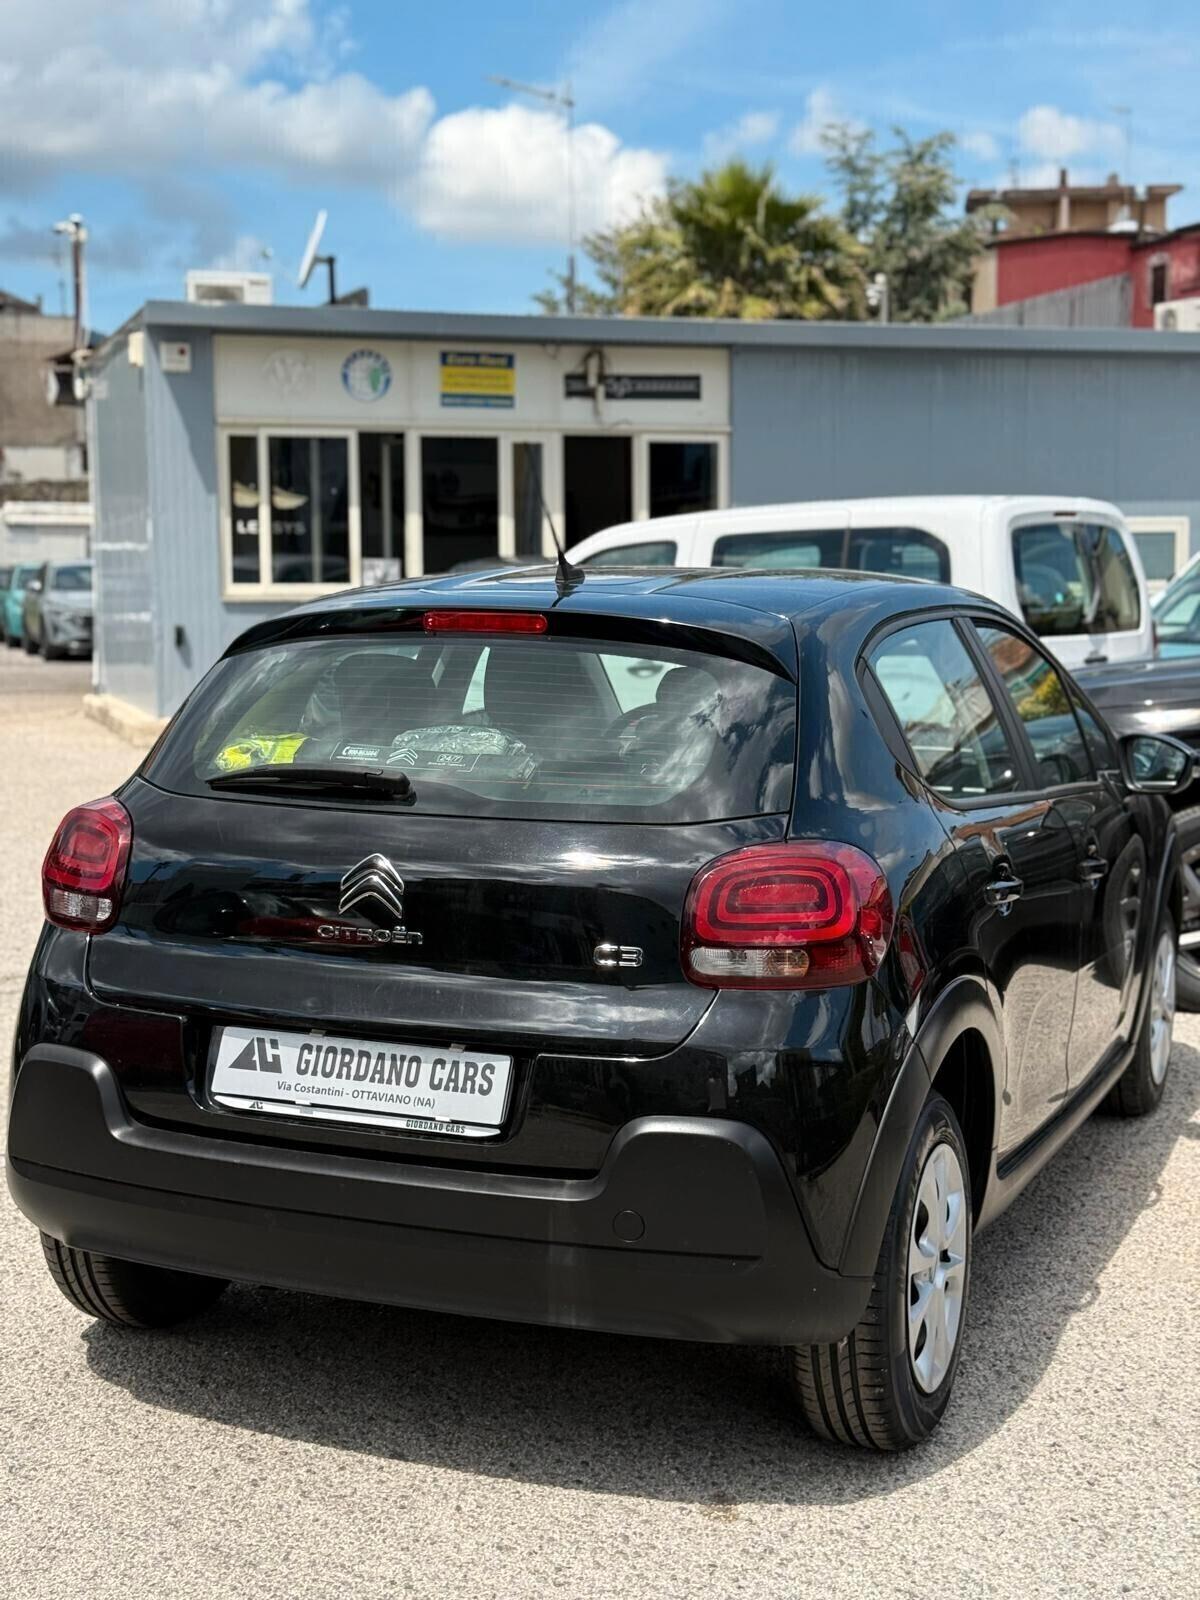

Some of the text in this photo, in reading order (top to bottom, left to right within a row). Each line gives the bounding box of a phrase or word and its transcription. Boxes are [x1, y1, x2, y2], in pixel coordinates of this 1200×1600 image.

[236, 519, 306, 535] LESYS
[593, 943, 643, 967] C3
[296, 1042, 496, 1096] GIORDANO CARS
[277, 1080, 292, 1092] Via
[294, 1082, 344, 1097] Costantini
[351, 1088, 411, 1105] OTTAVIANO
[413, 1096, 436, 1109] (NA)
[405, 1119, 466, 1134] GIORDANO CARS
